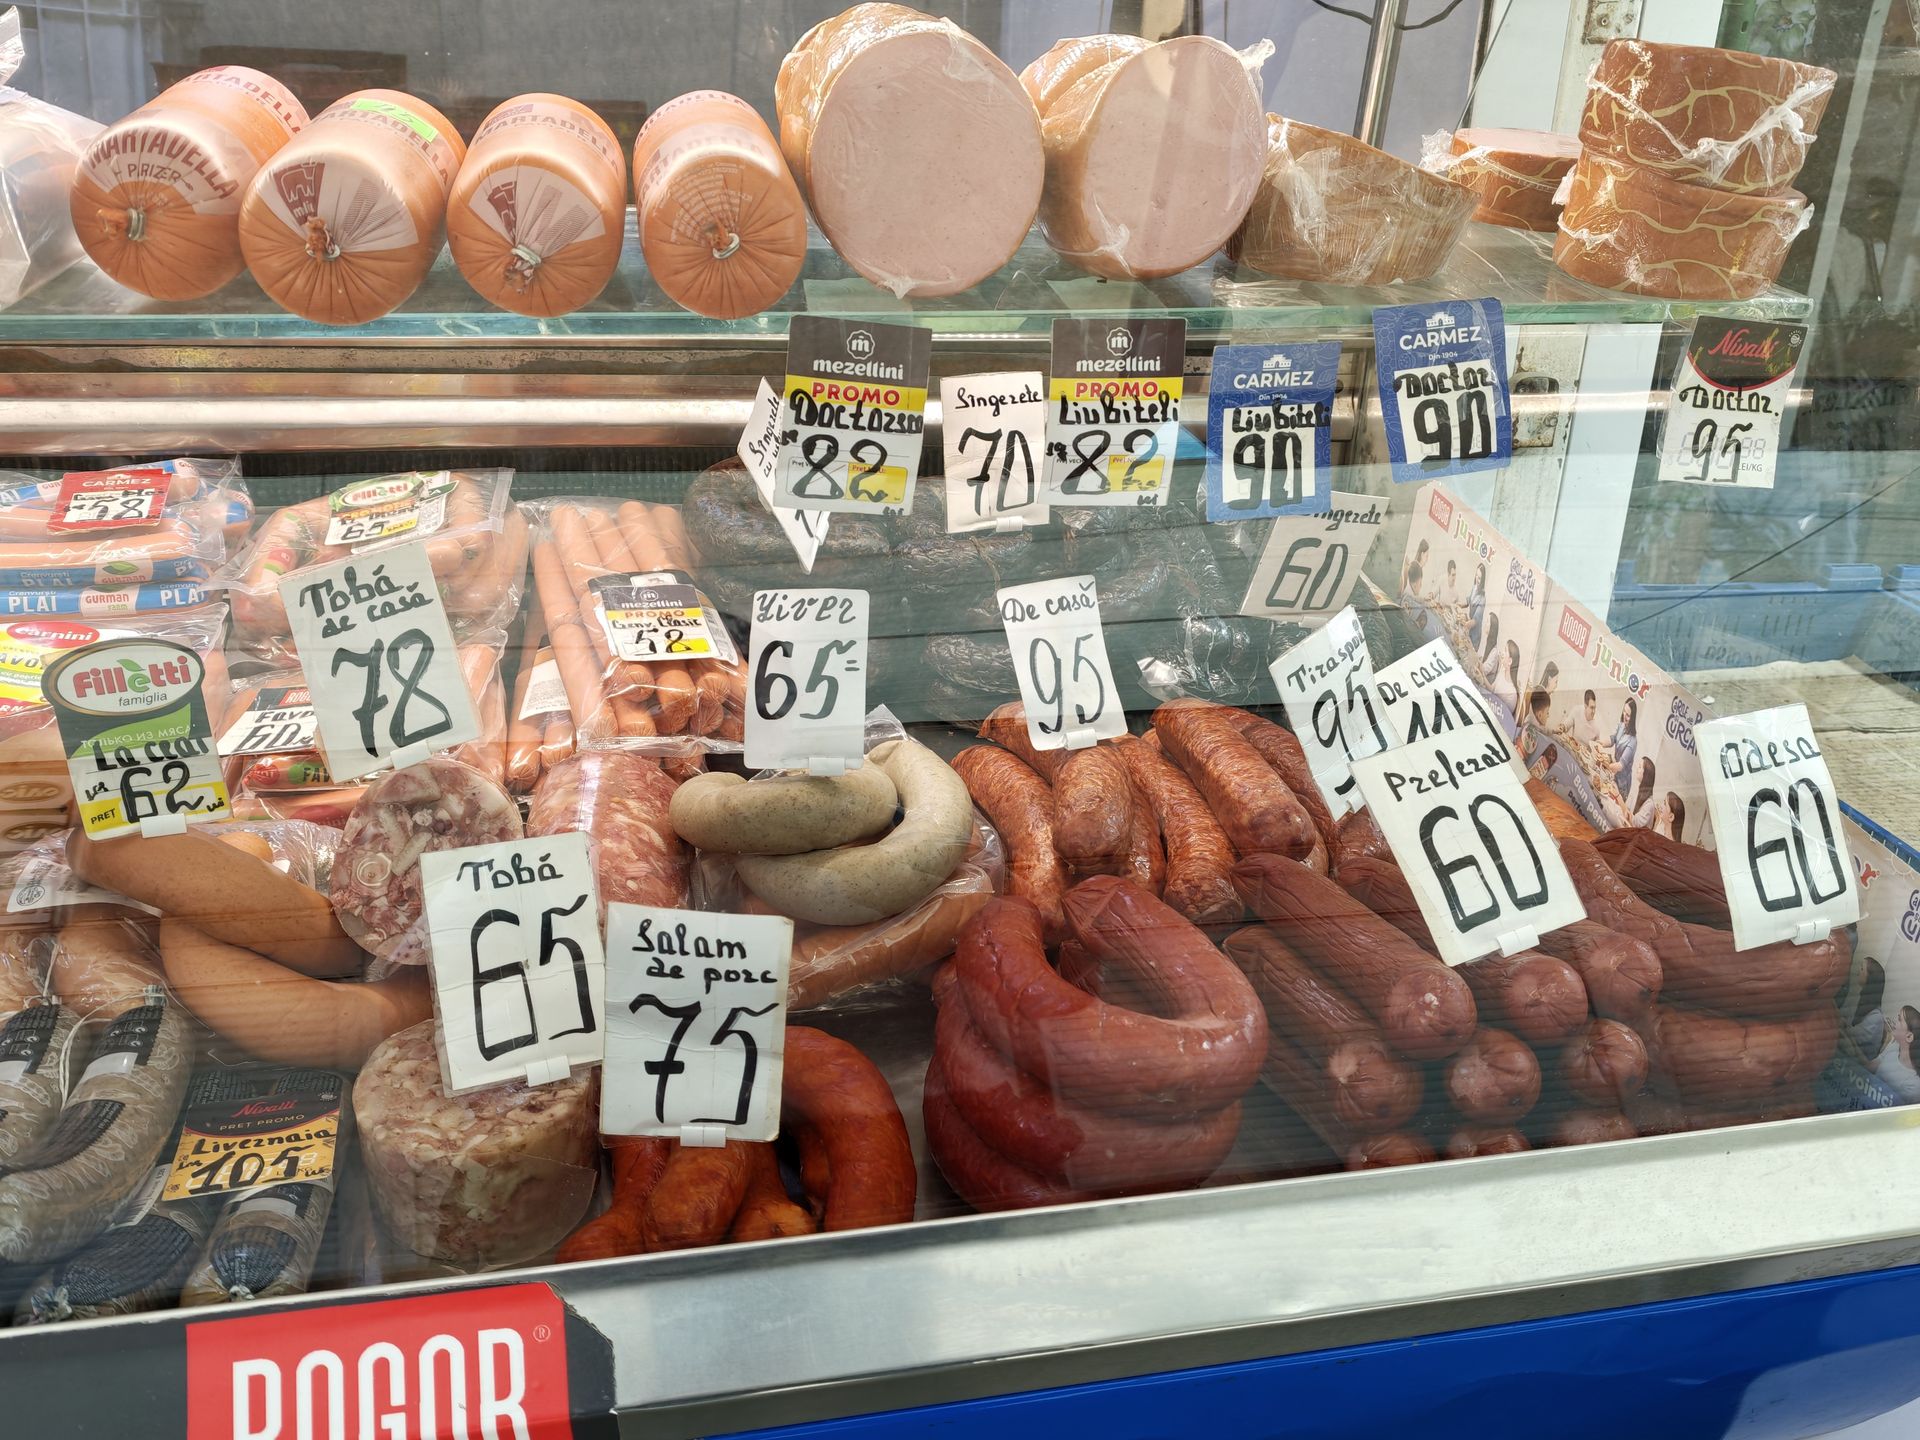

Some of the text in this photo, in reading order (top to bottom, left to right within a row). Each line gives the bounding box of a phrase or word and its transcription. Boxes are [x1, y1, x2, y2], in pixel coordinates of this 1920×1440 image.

[1399, 326, 1482, 350] CARMEZ
[812, 358, 904, 380] mezellini
[1076, 356, 1161, 372] mezellini
[811, 382, 901, 406] PROMO
[1075, 381, 1158, 398] PROMO
[1233, 371, 1314, 388] CARMEZ
[1413, 390, 1492, 471] 90
[1683, 418, 1753, 483] 95
[792, 434, 888, 503] 82
[958, 427, 1035, 516] 70
[1226, 432, 1302, 510] 90
[83, 479, 151, 488] CARMEZ
[76, 498, 144, 523] 58
[1454, 513, 1496, 563] junior
[1265, 537, 1349, 610] 60
[8, 596, 57, 613] PLAI
[621, 599, 683, 609] mezellini
[625, 609, 685, 619] PROMO
[1001, 598, 1040, 623] De
[321, 615, 357, 639] de
[634, 627, 694, 656] 58
[1562, 612, 1588, 649] ROGOB
[72, 655, 192, 699] Filletti
[1592, 635, 1652, 700] junior
[285, 690, 312, 704] ROG
[331, 628, 454, 758] 78
[1029, 633, 1105, 734] 95
[1376, 682, 1409, 706] De
[118, 692, 168, 707] famiglia
[136, 732, 155, 741] ИЗ
[158, 725, 191, 738] МЯСА
[233, 723, 302, 751] 60
[120, 761, 204, 823] 62
[1573, 774, 1588, 803] Bun
[1587, 801, 1610, 832] pent
[1747, 777, 1847, 913] 60
[1419, 793, 1549, 934] 60
[632, 918, 747, 960] Salam
[470, 894, 597, 1062] 65
[646, 957, 685, 980] de
[628, 993, 780, 1125] 75
[257, 1114, 305, 1125] PROMO
[188, 1144, 316, 1195] 105
